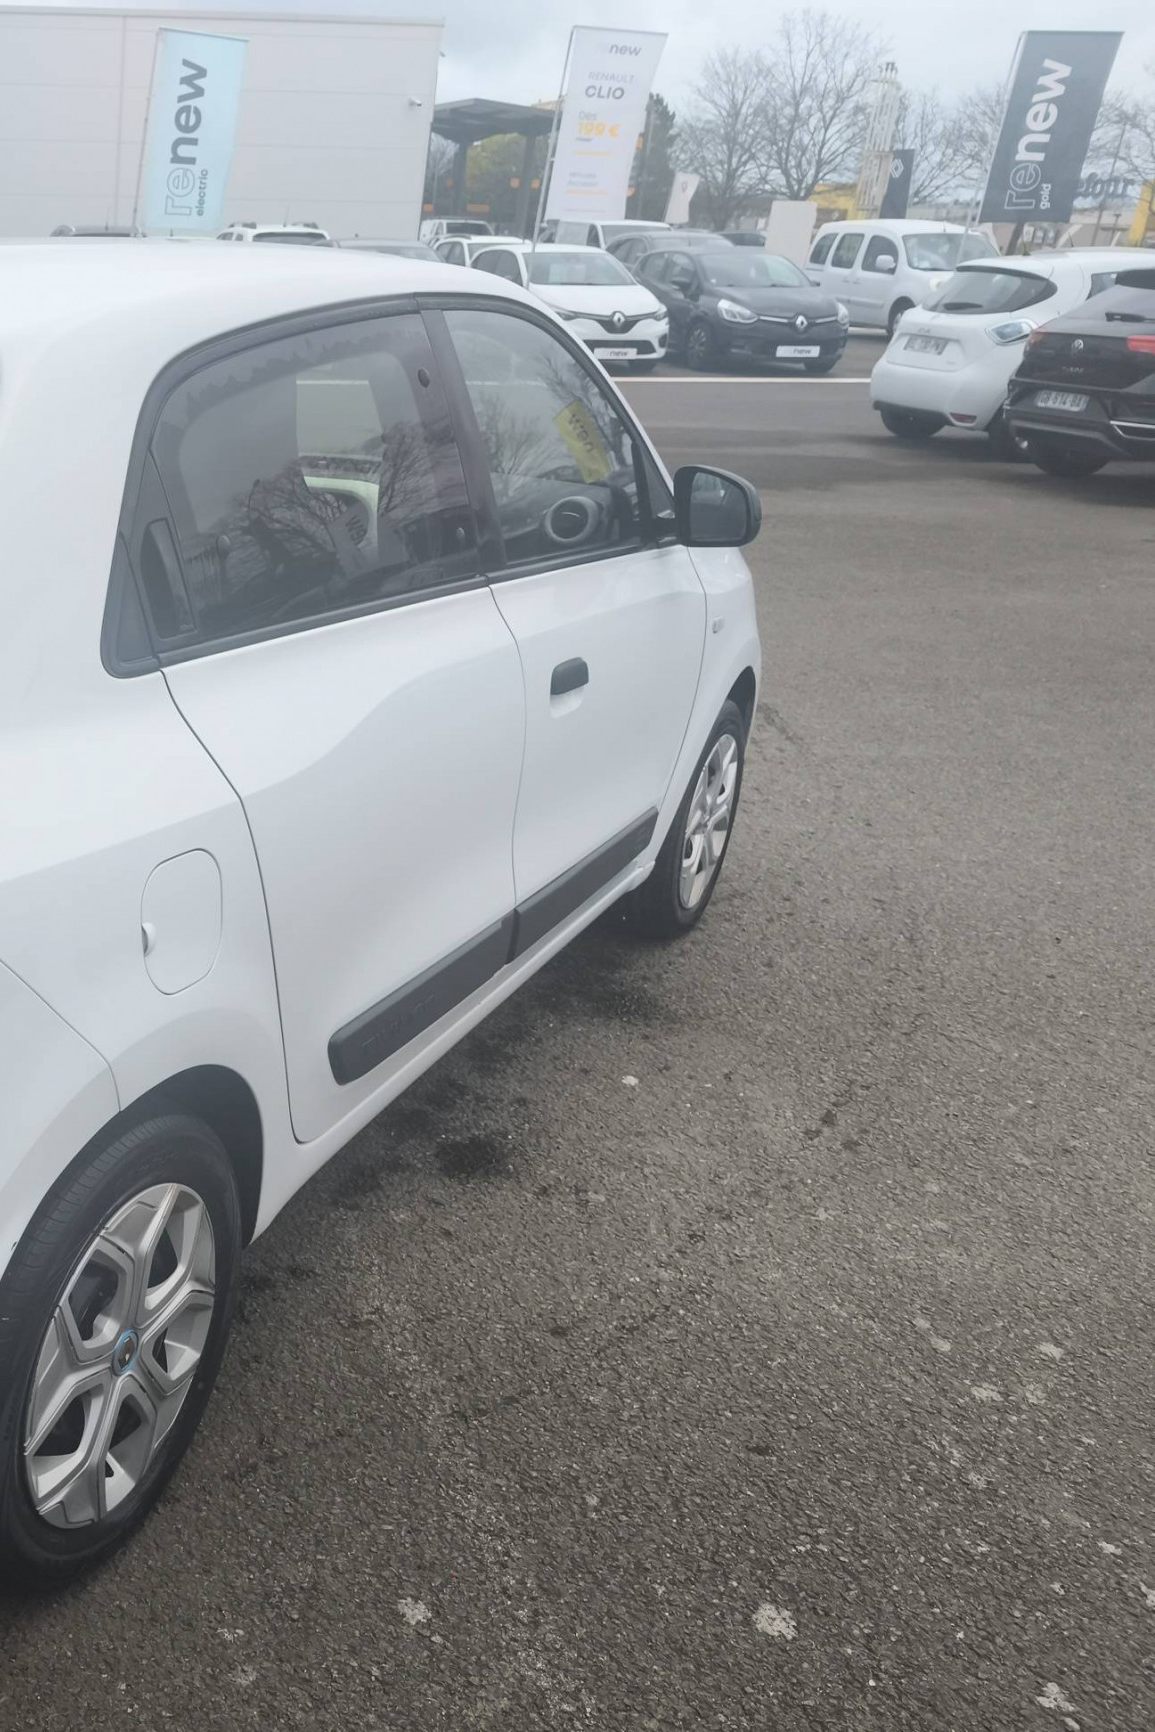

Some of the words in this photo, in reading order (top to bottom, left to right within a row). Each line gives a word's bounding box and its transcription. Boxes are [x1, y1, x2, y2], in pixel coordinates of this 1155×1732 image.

[585, 85, 625, 100] CLIO
[588, 72, 635, 83] RENAULT
[165, 58, 208, 216] renew
[1004, 58, 1072, 210] renew
[195, 168, 209, 217] electric
[1039, 183, 1052, 210] gold
